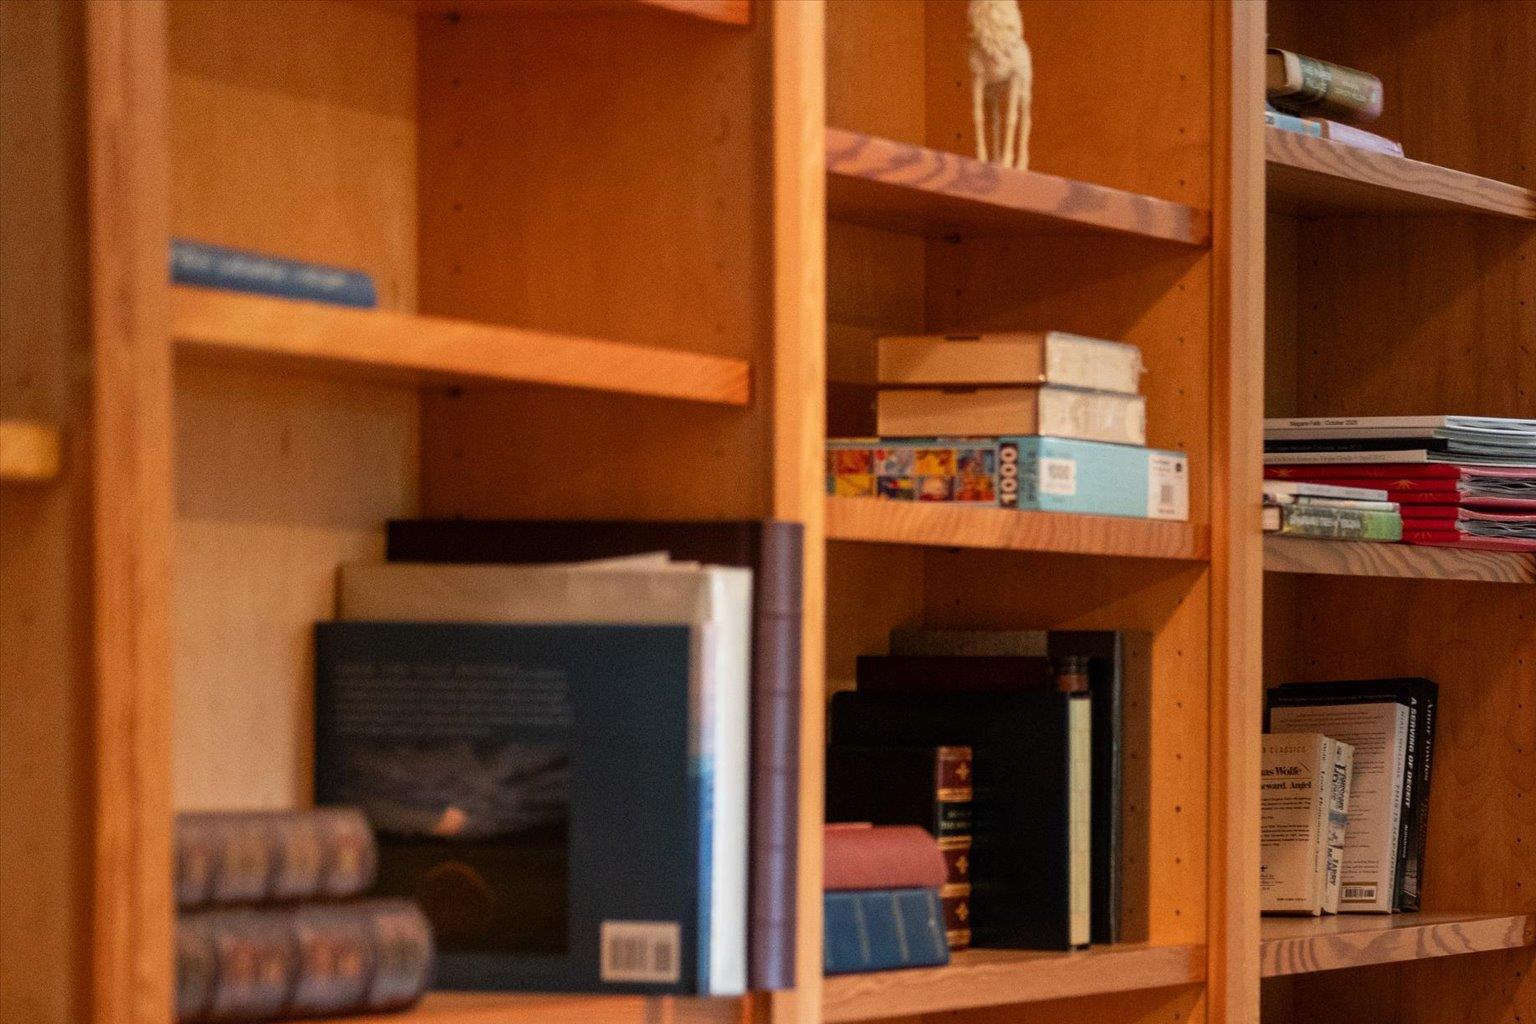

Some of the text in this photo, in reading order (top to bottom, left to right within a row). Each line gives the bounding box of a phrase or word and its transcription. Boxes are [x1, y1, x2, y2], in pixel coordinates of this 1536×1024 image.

[1000, 447, 1017, 504] 1000
[1404, 697, 1417, 808] A SERVING OF DECEIT
[1275, 766, 1301, 776] Wolfe
[1290, 781, 1312, 790] Angel
